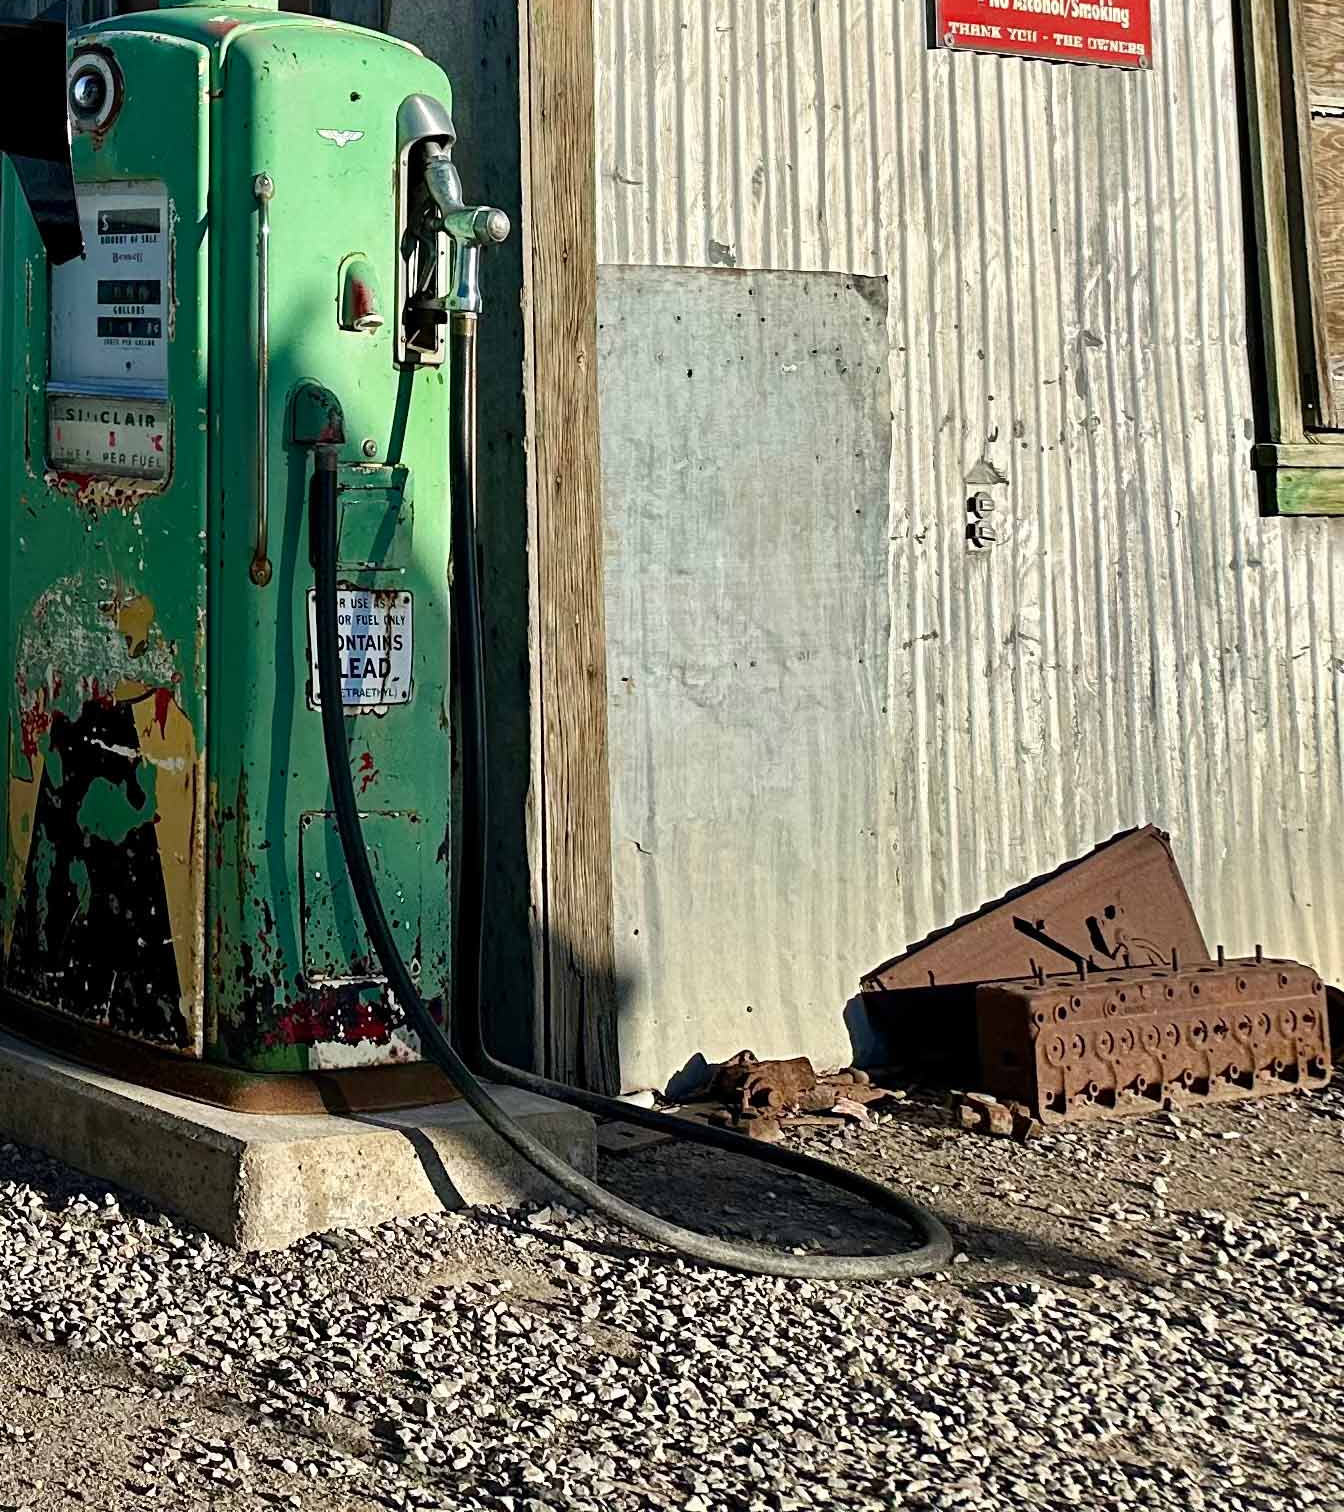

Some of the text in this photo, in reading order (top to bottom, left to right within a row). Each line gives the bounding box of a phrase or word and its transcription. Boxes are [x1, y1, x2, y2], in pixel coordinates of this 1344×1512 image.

[948, 21, 1002, 39] THANK
[1006, 27, 1037, 43] YOU
[1053, 33, 1083, 48] THE
[1087, 37, 1145, 55] OWNERS
[350, 598, 370, 609] USE
[356, 615, 380, 625] FUEL
[338, 635, 403, 651] ONTAINS
[339, 657, 392, 679] LEAD
